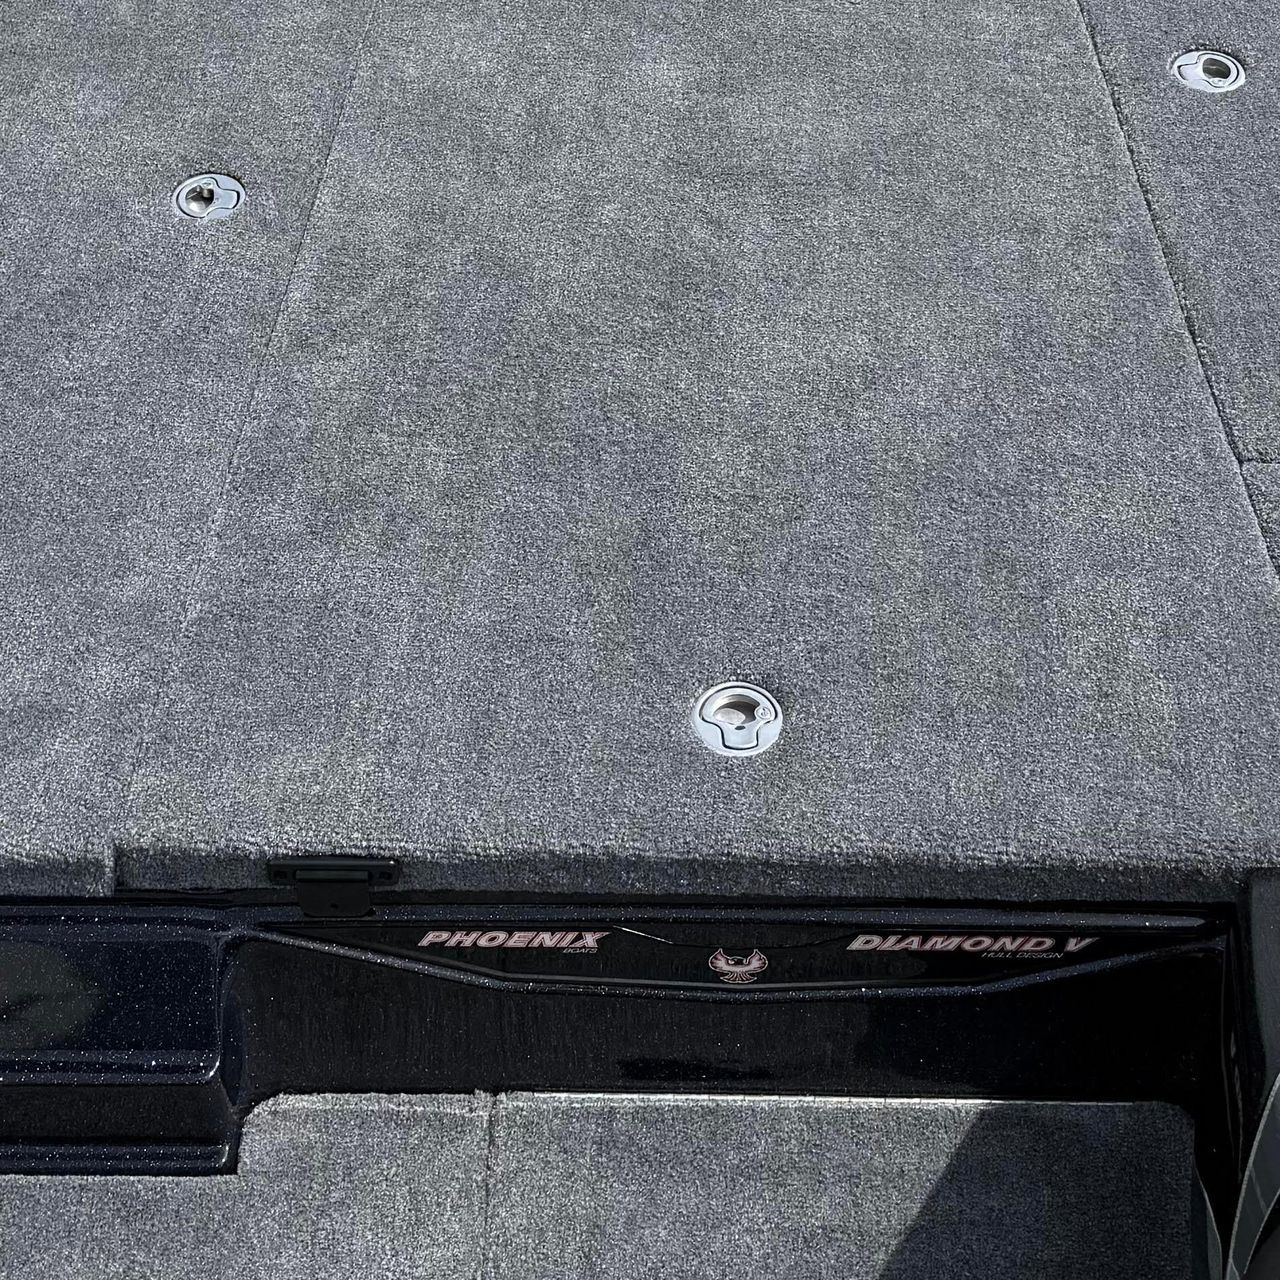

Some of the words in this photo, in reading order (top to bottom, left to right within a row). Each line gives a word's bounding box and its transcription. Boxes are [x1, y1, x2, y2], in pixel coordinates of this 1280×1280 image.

[417, 930, 612, 948] PHOENIX
[846, 934, 1056, 952] DIAMOND
[1064, 936, 1101, 953] V
